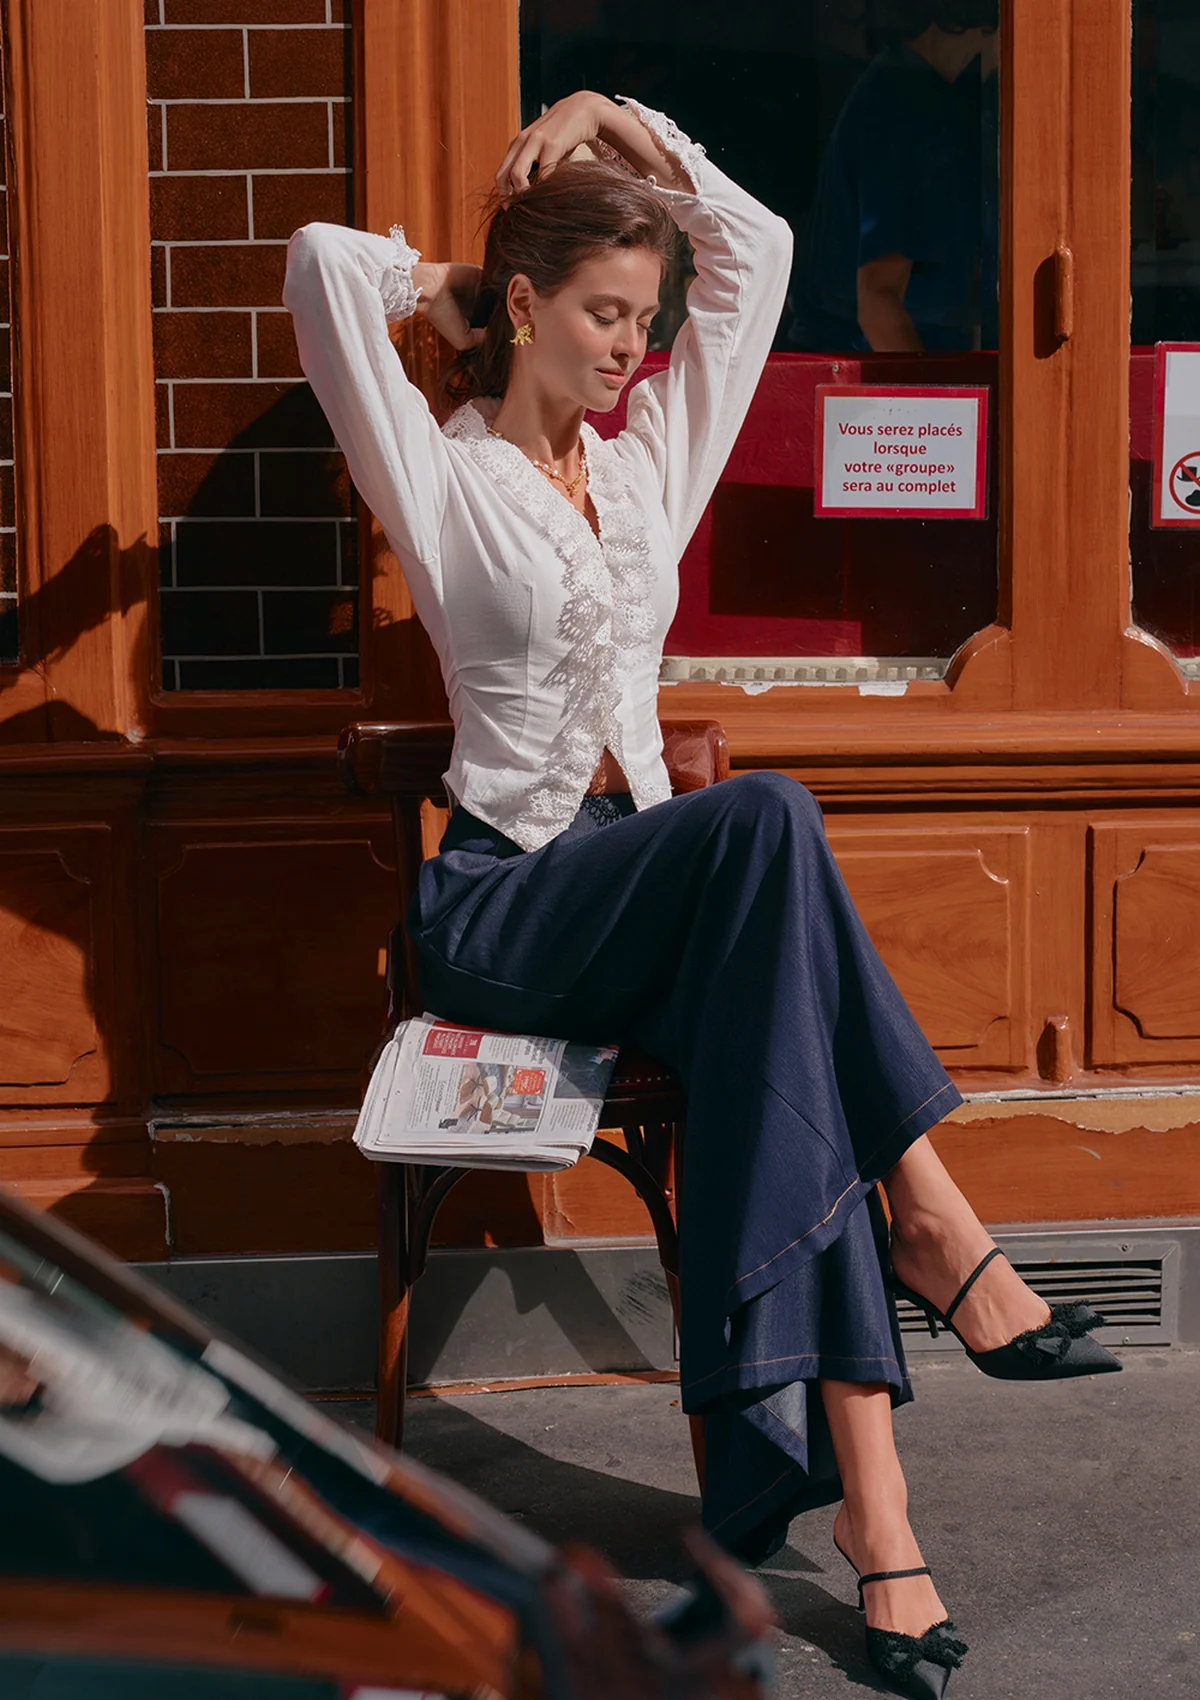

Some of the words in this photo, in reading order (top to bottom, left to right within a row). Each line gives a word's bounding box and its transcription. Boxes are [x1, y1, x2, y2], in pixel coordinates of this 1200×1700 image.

[838, 423, 873, 436] Vous
[877, 425, 914, 436] serez
[917, 423, 963, 438] placés
[873, 441, 927, 457] lorsque
[844, 462, 882, 473] votre
[886, 463, 955, 476] «groupe»
[842, 481, 872, 492] sera
[876, 481, 893, 492] au
[898, 480, 956, 495] complet
